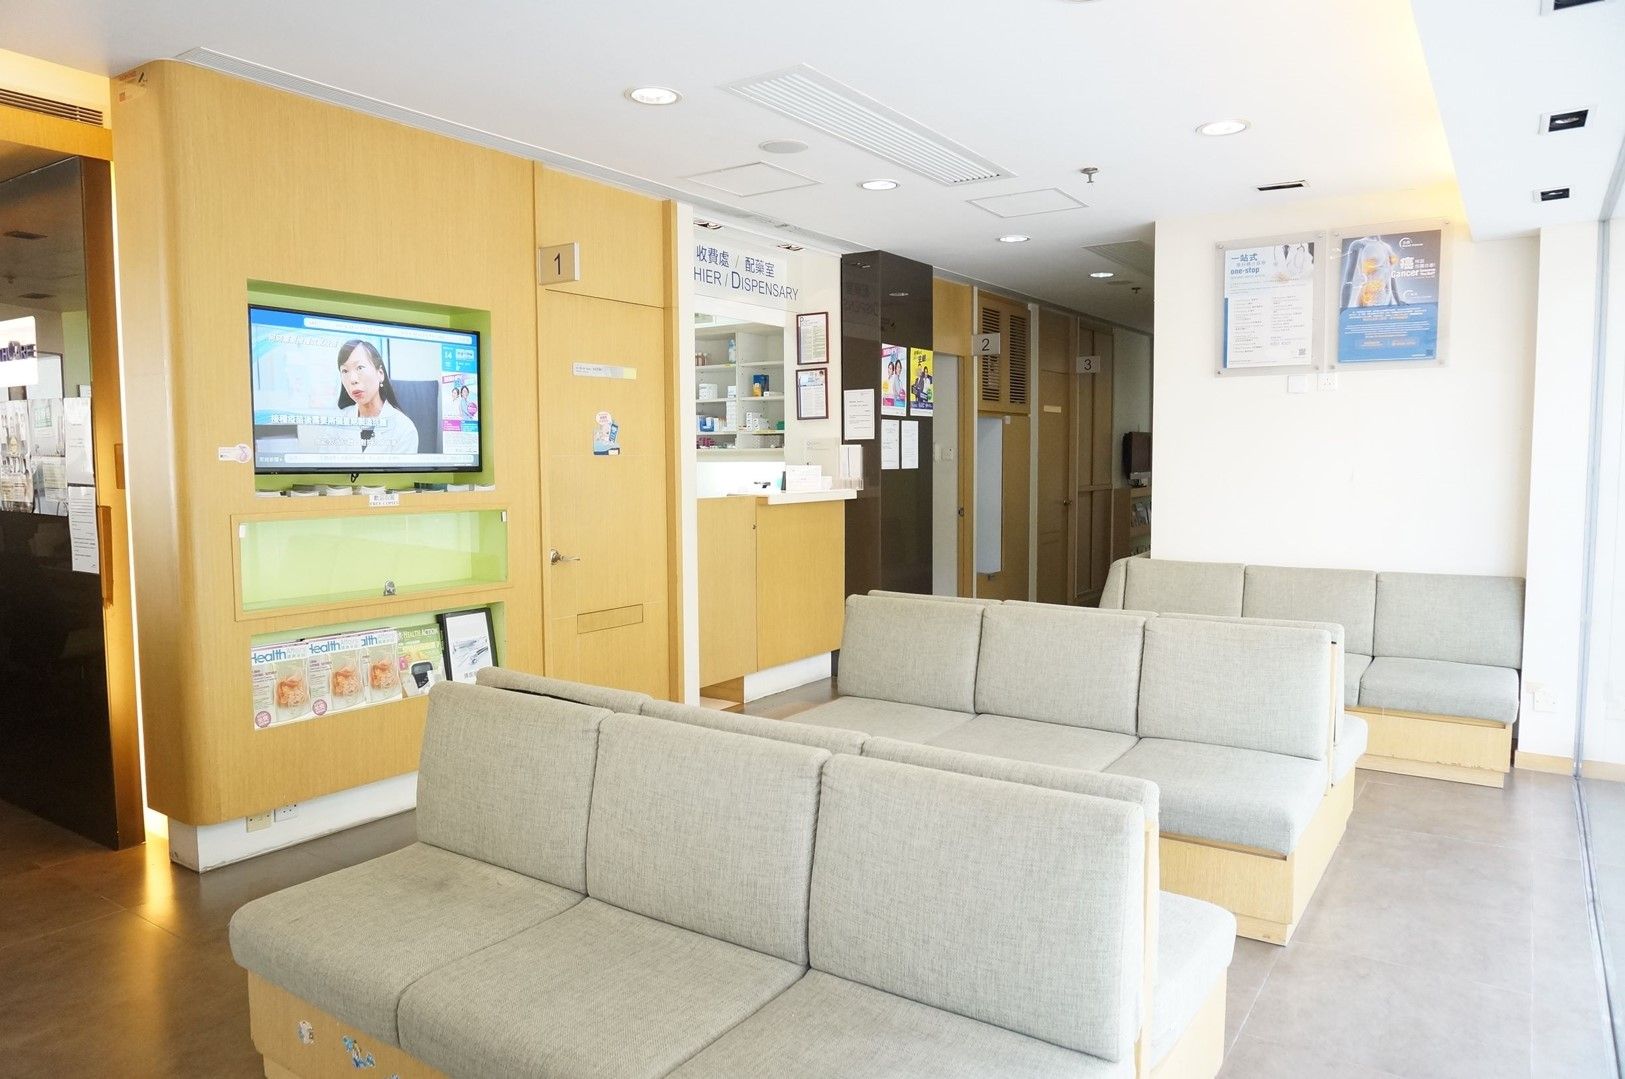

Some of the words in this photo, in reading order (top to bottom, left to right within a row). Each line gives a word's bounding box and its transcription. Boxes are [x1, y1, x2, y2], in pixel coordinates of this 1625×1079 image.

[696, 244, 730, 268] 收費處
[1231, 252, 1258, 262] 一站式
[554, 252, 561, 275] 1
[1230, 267, 1260, 275] one-stop
[1390, 269, 1419, 279] Cancer
[731, 271, 799, 301] DISPENSARY
[981, 338, 990, 352] 2
[1083, 358, 1093, 371] 3
[309, 639, 341, 654] Health
[252, 649, 287, 664] Health
